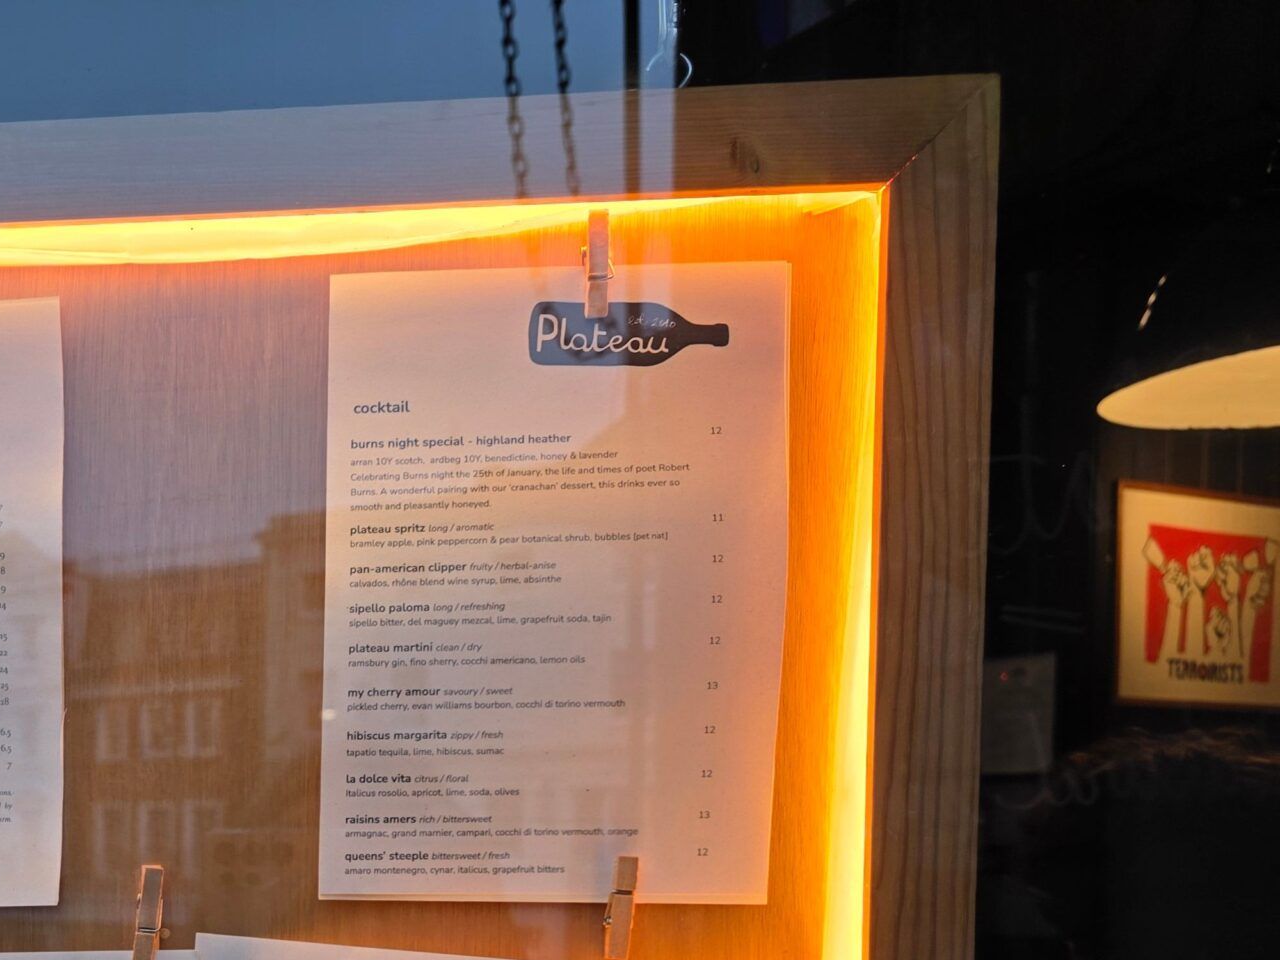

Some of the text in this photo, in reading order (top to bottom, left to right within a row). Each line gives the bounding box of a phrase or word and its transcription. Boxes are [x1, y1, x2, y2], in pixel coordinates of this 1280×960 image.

[536, 314, 669, 354] Plateau
[353, 400, 409, 413] cocktail
[710, 426, 722, 434] 12
[351, 434, 571, 449] burns night special highland heather
[350, 472, 400, 481] Celebrating
[431, 471, 454, 480] night
[473, 469, 493, 478] 25th
[561, 466, 575, 474] life
[578, 466, 594, 474] and
[596, 465, 621, 473] times
[635, 464, 656, 473] poet
[350, 502, 382, 511] smooth
[403, 500, 449, 511] pleasantly
[712, 513, 723, 524] 11
[350, 523, 425, 536] plateau spritz
[712, 554, 723, 562] 12
[350, 562, 466, 575] pan-american clipper
[712, 594, 722, 603] 12
[349, 603, 429, 614] sipello paloma
[710, 636, 720, 644] 12
[349, 642, 432, 654] plateau martini
[707, 681, 719, 689] 13
[348, 690, 364, 698] my
[367, 687, 402, 698] cherry
[704, 725, 715, 733] 12
[347, 730, 446, 741] hibiscus margarita
[346, 773, 411, 783] la dolce vita
[701, 769, 712, 777] 12
[345, 814, 380, 823] raisins
[698, 810, 710, 818] 13
[389, 851, 429, 861] steeple
[697, 847, 708, 856] 12
